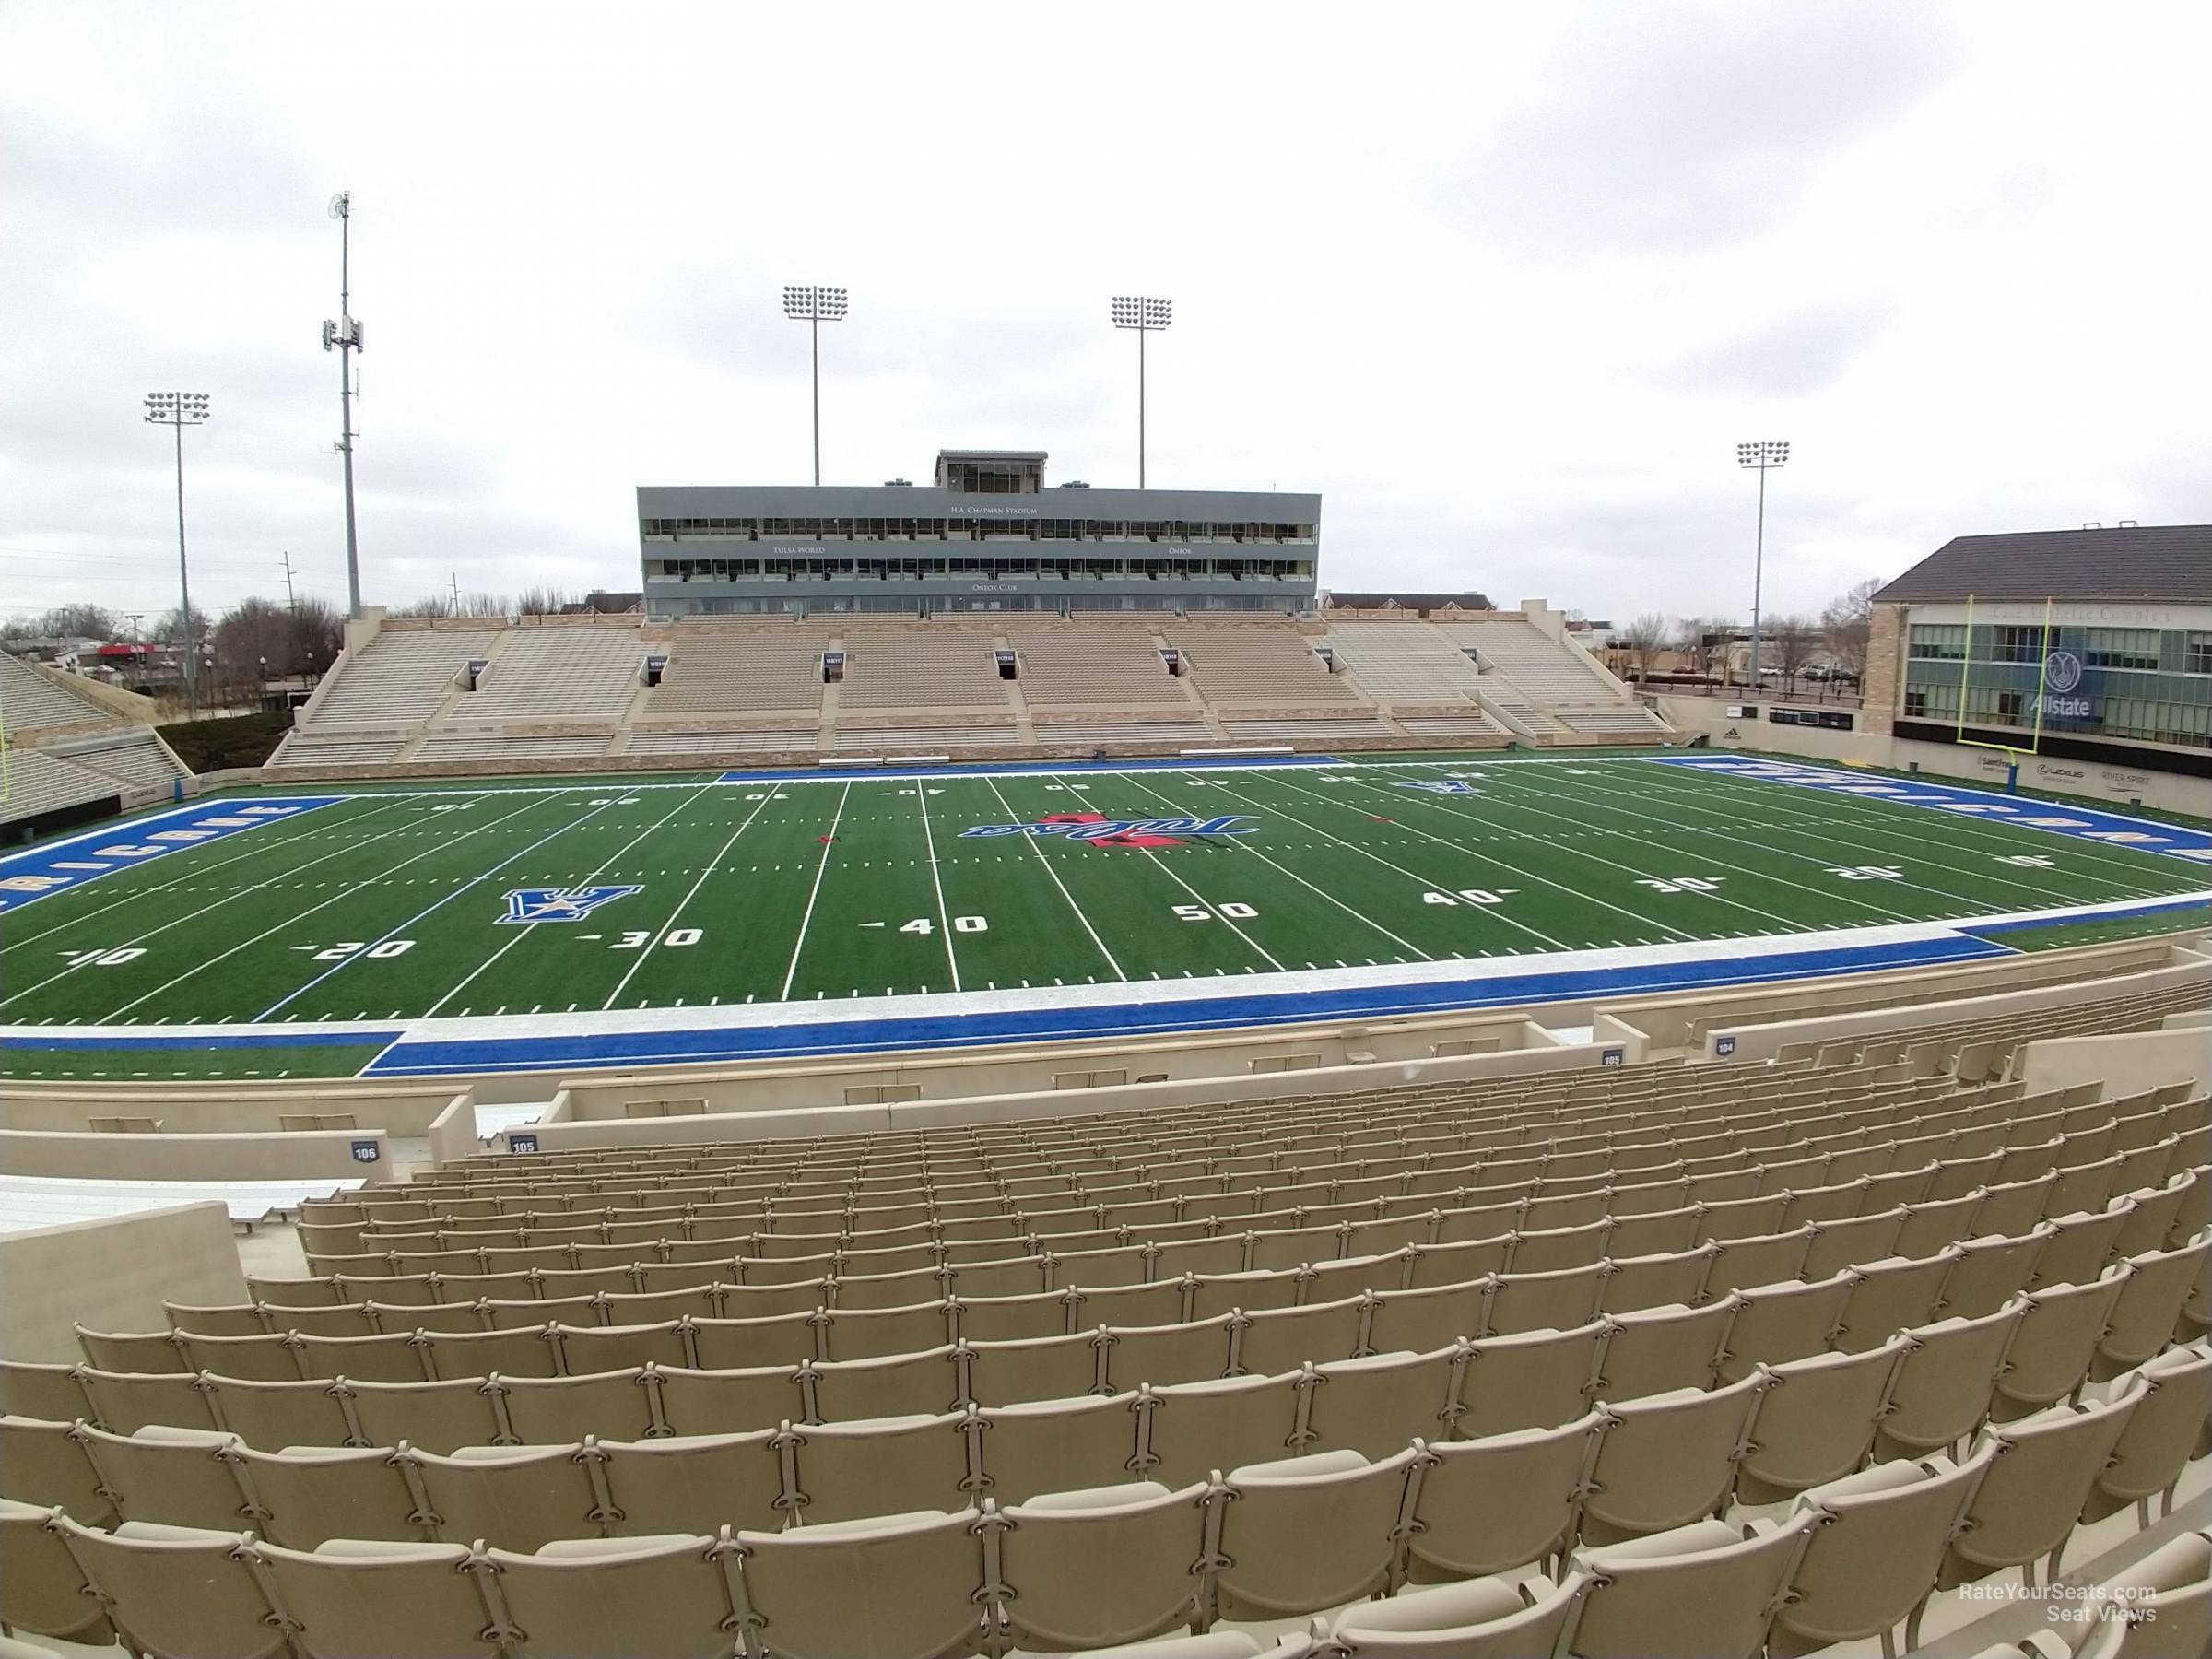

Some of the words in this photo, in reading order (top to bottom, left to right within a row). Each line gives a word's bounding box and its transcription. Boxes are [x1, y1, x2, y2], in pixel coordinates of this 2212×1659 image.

[967, 506, 1004, 514] CHAPMAN
[1005, 507, 1038, 515] STADIUM
[773, 546, 797, 554] TULSA
[2030, 693, 2090, 716] Allstate
[2101, 771, 2125, 782] RIVER
[1823, 865, 1904, 880] 20
[1633, 877, 1722, 893] 30
[1422, 888, 1505, 906] 40
[1171, 901, 1260, 922] 50
[899, 914, 990, 935] 40
[606, 927, 704, 949] 30
[66, 947, 148, 966] 10
[310, 939, 418, 960] 20
[1718, 1042, 1734, 1053] 104
[1604, 1054, 1621, 1065] 105
[354, 1147, 377, 1159] 106
[512, 1141, 535, 1153] 105
